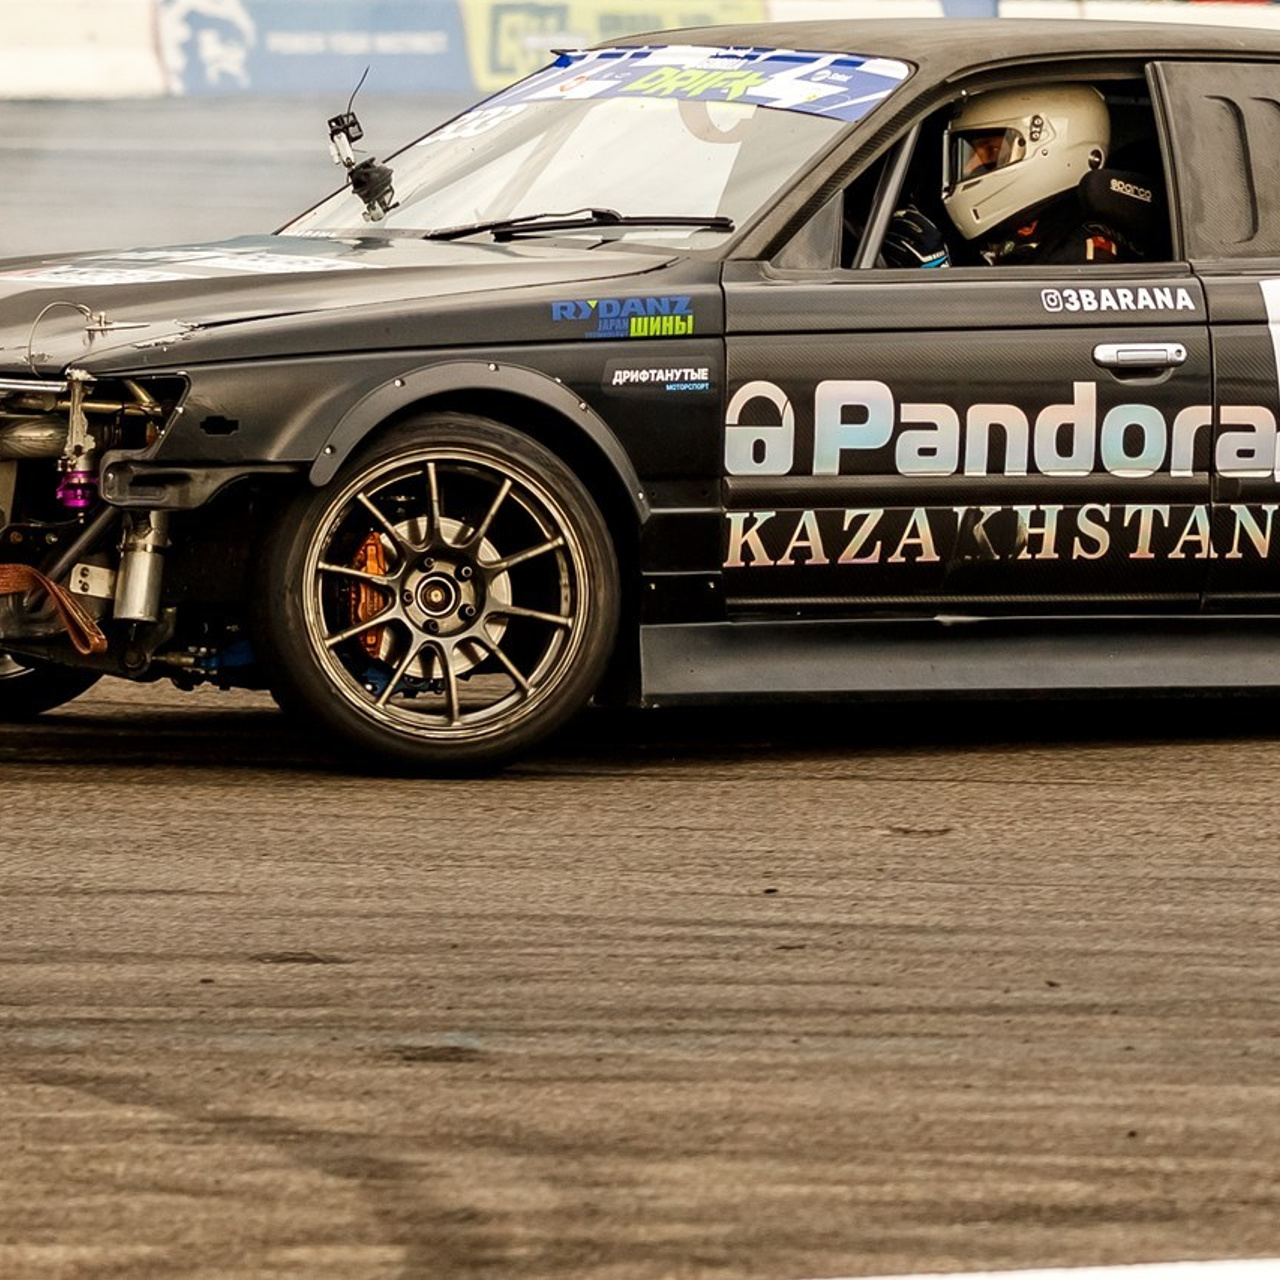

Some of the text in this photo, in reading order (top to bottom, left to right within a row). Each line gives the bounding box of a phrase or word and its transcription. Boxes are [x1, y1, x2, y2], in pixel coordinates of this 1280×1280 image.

[618, 66, 768, 100] DRIFT
[1110, 178, 1152, 200] sparco
[551, 295, 694, 321] RYDANZ
[629, 315, 694, 338] ШИНЫ
[612, 368, 709, 386] ДРИФТАНУТЫЕ
[665, 382, 709, 392] МОТОРСПОРТ
[812, 380, 1277, 478] Pandora
[722, 503, 1279, 568] KAZAKHSTAN
